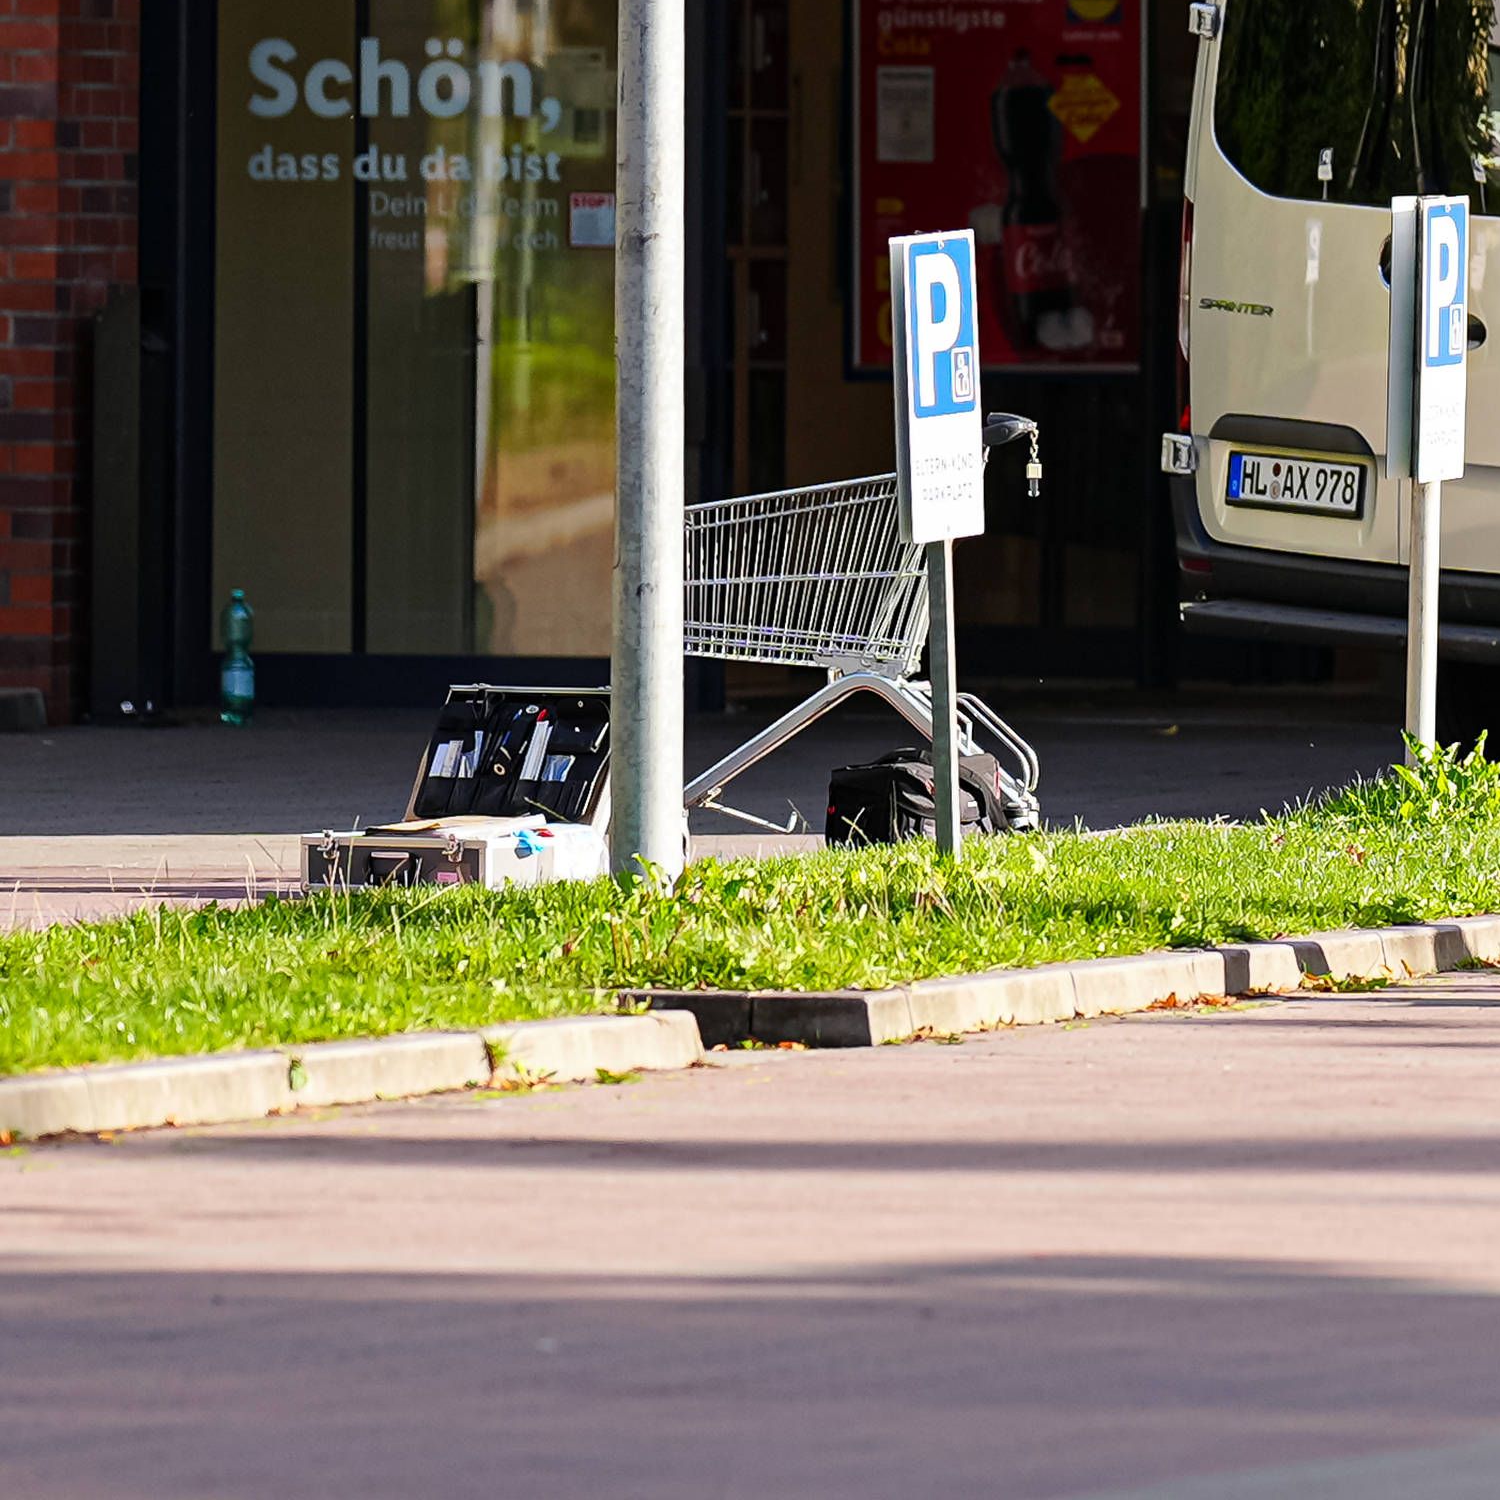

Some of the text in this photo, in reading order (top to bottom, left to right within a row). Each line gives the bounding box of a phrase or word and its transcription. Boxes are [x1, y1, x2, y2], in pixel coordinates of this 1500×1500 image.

[877, 5, 1007, 35] günstigste
[247, 36, 562, 133] Schön,
[248, 142, 561, 182] dass du da bist
[369, 190, 427, 218] Dein
[369, 226, 418, 251] freut
[1429, 215, 1460, 357] P
[1199, 298, 1274, 317] SPRINTER
[915, 252, 961, 408] P
[1241, 460, 1268, 496] HL
[1281, 464, 1311, 501] AX
[1313, 468, 1356, 505] 978
